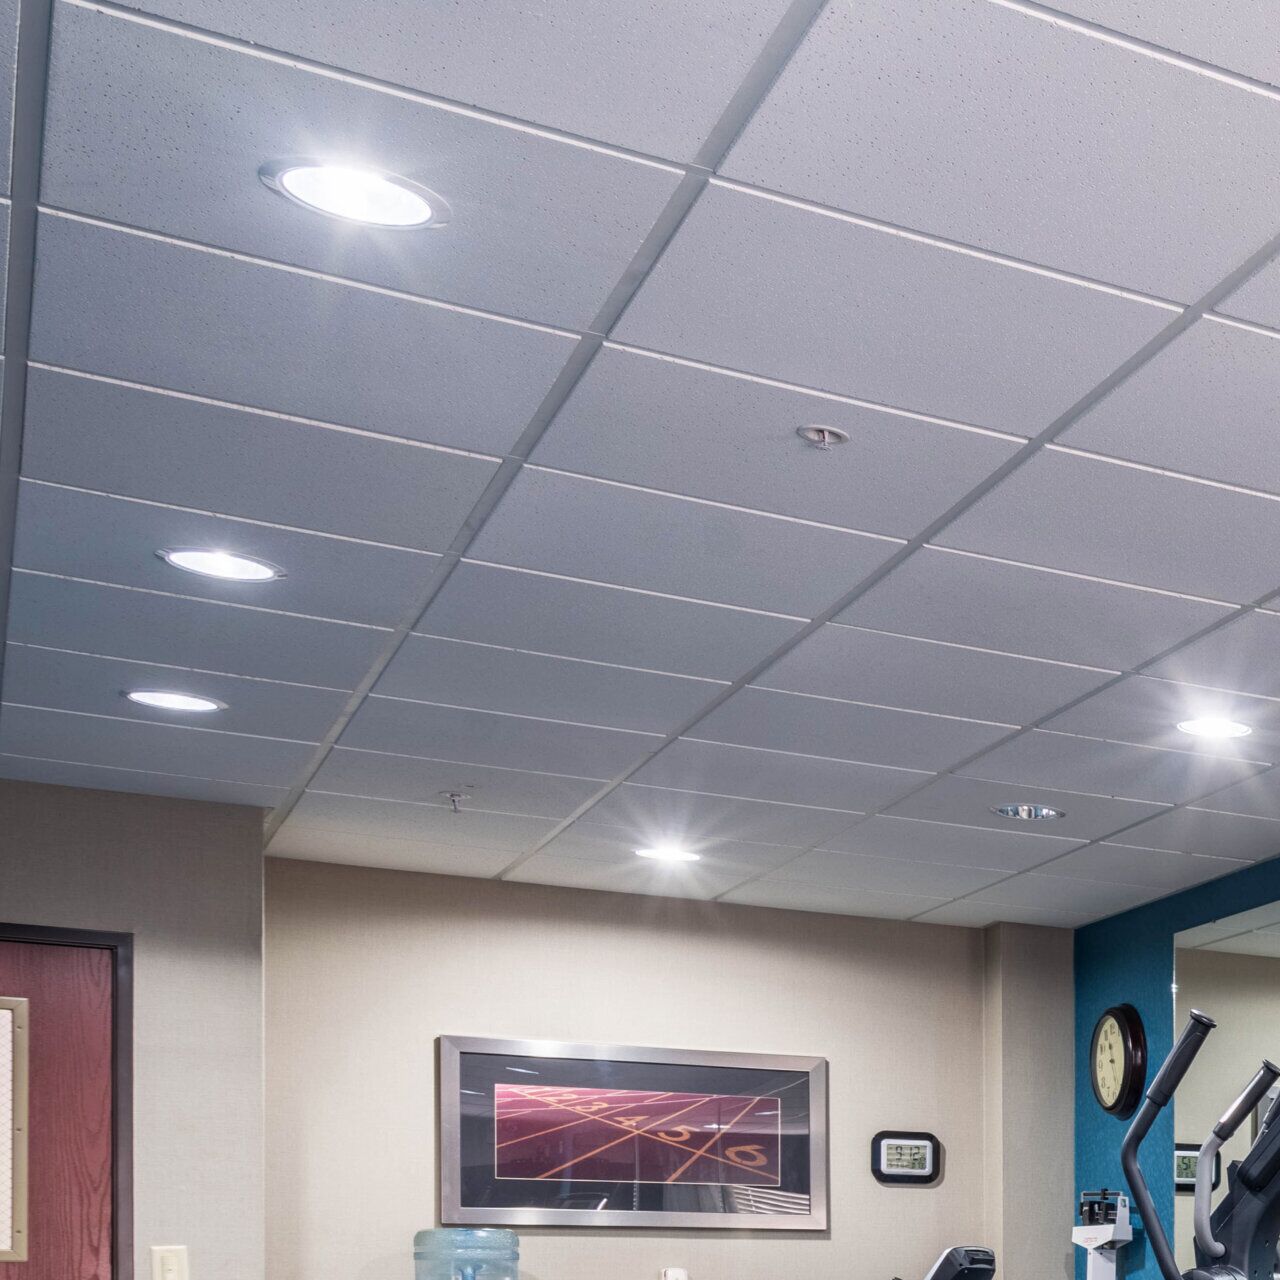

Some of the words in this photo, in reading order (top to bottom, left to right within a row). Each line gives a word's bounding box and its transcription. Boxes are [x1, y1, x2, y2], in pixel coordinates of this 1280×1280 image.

[575, 1101, 609, 1112] 3
[613, 1115, 650, 1127] 4
[657, 1124, 700, 1142] 5
[724, 1144, 769, 1167] 6
